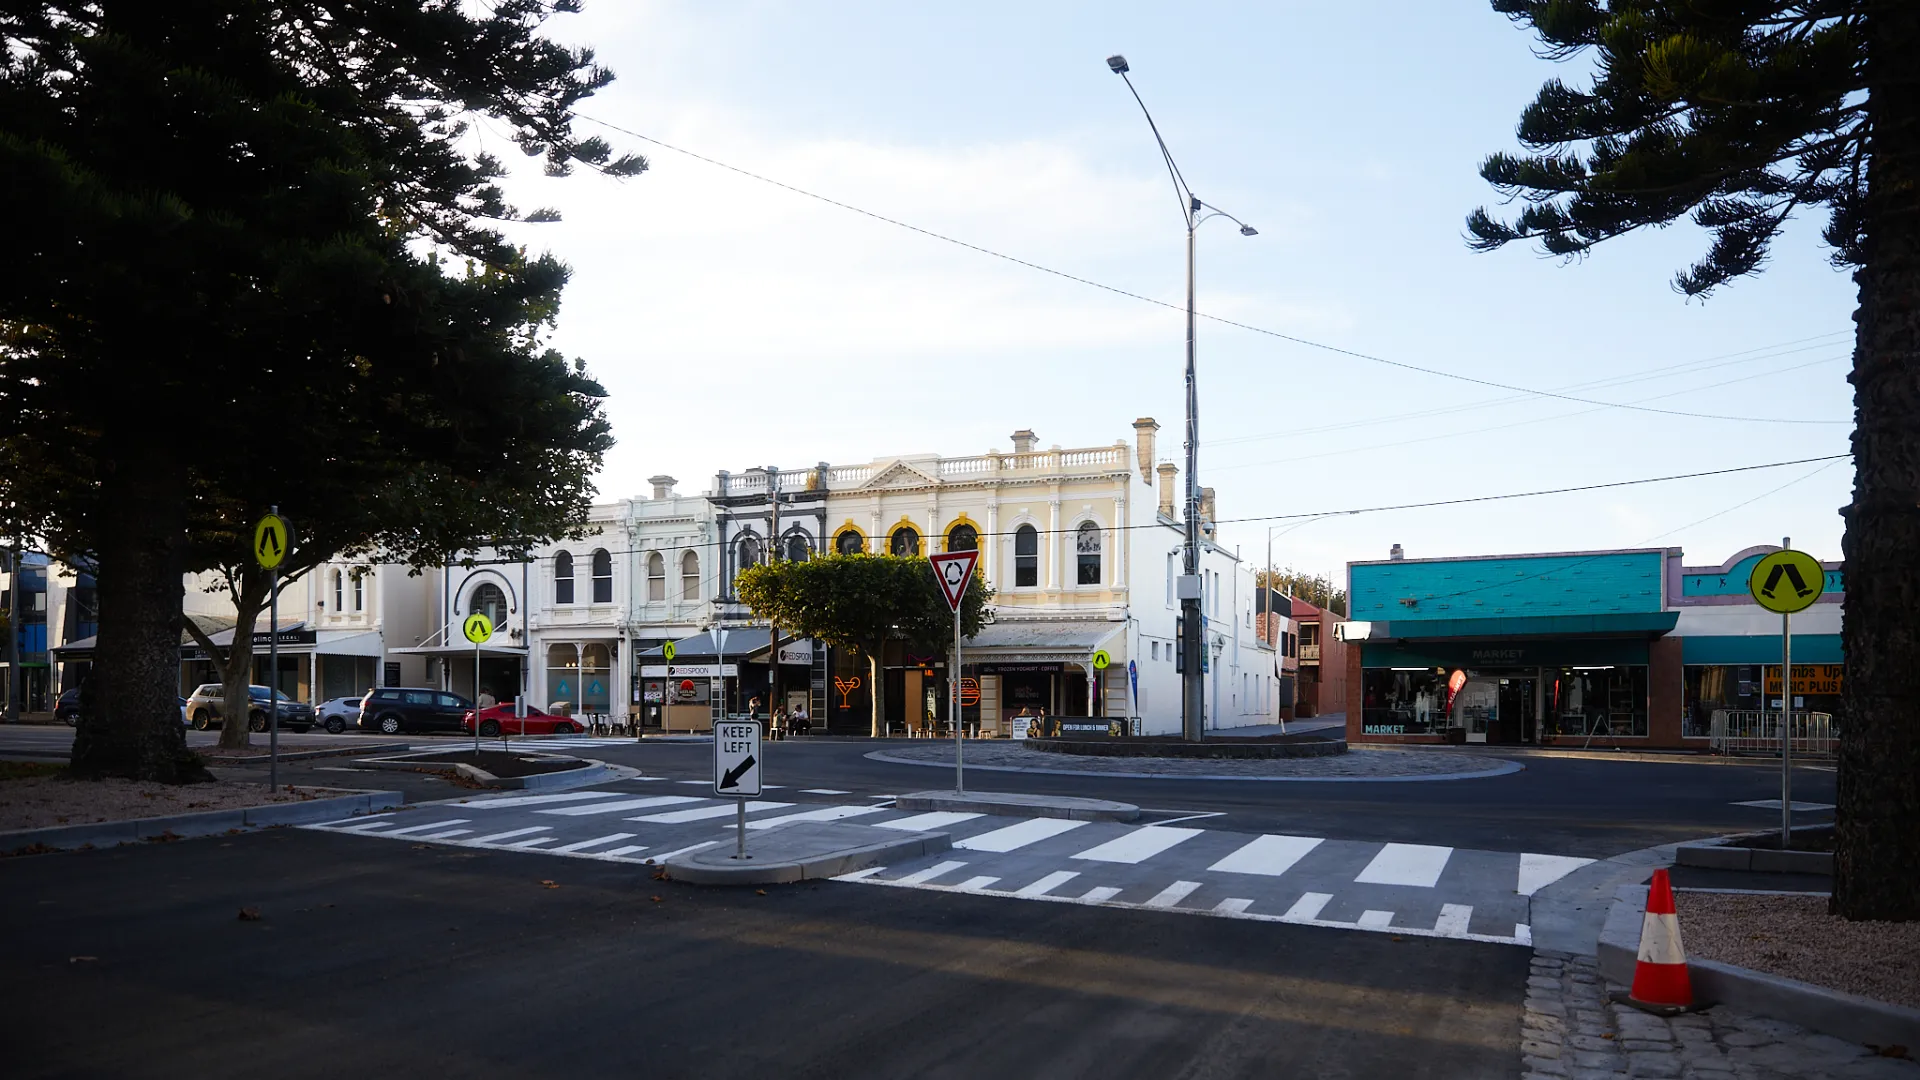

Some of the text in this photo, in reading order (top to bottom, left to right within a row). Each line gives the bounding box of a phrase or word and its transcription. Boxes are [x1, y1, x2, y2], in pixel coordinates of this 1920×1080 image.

[1472, 649, 1525, 659] MARKET
[1765, 665, 1815, 678] Thmbs
[1770, 681, 1804, 692] MSIC
[1809, 681, 1838, 692] PLUS
[723, 726, 753, 738] KEEP
[1365, 724, 1405, 734] MARKET
[724, 741, 752, 753] LEFT
